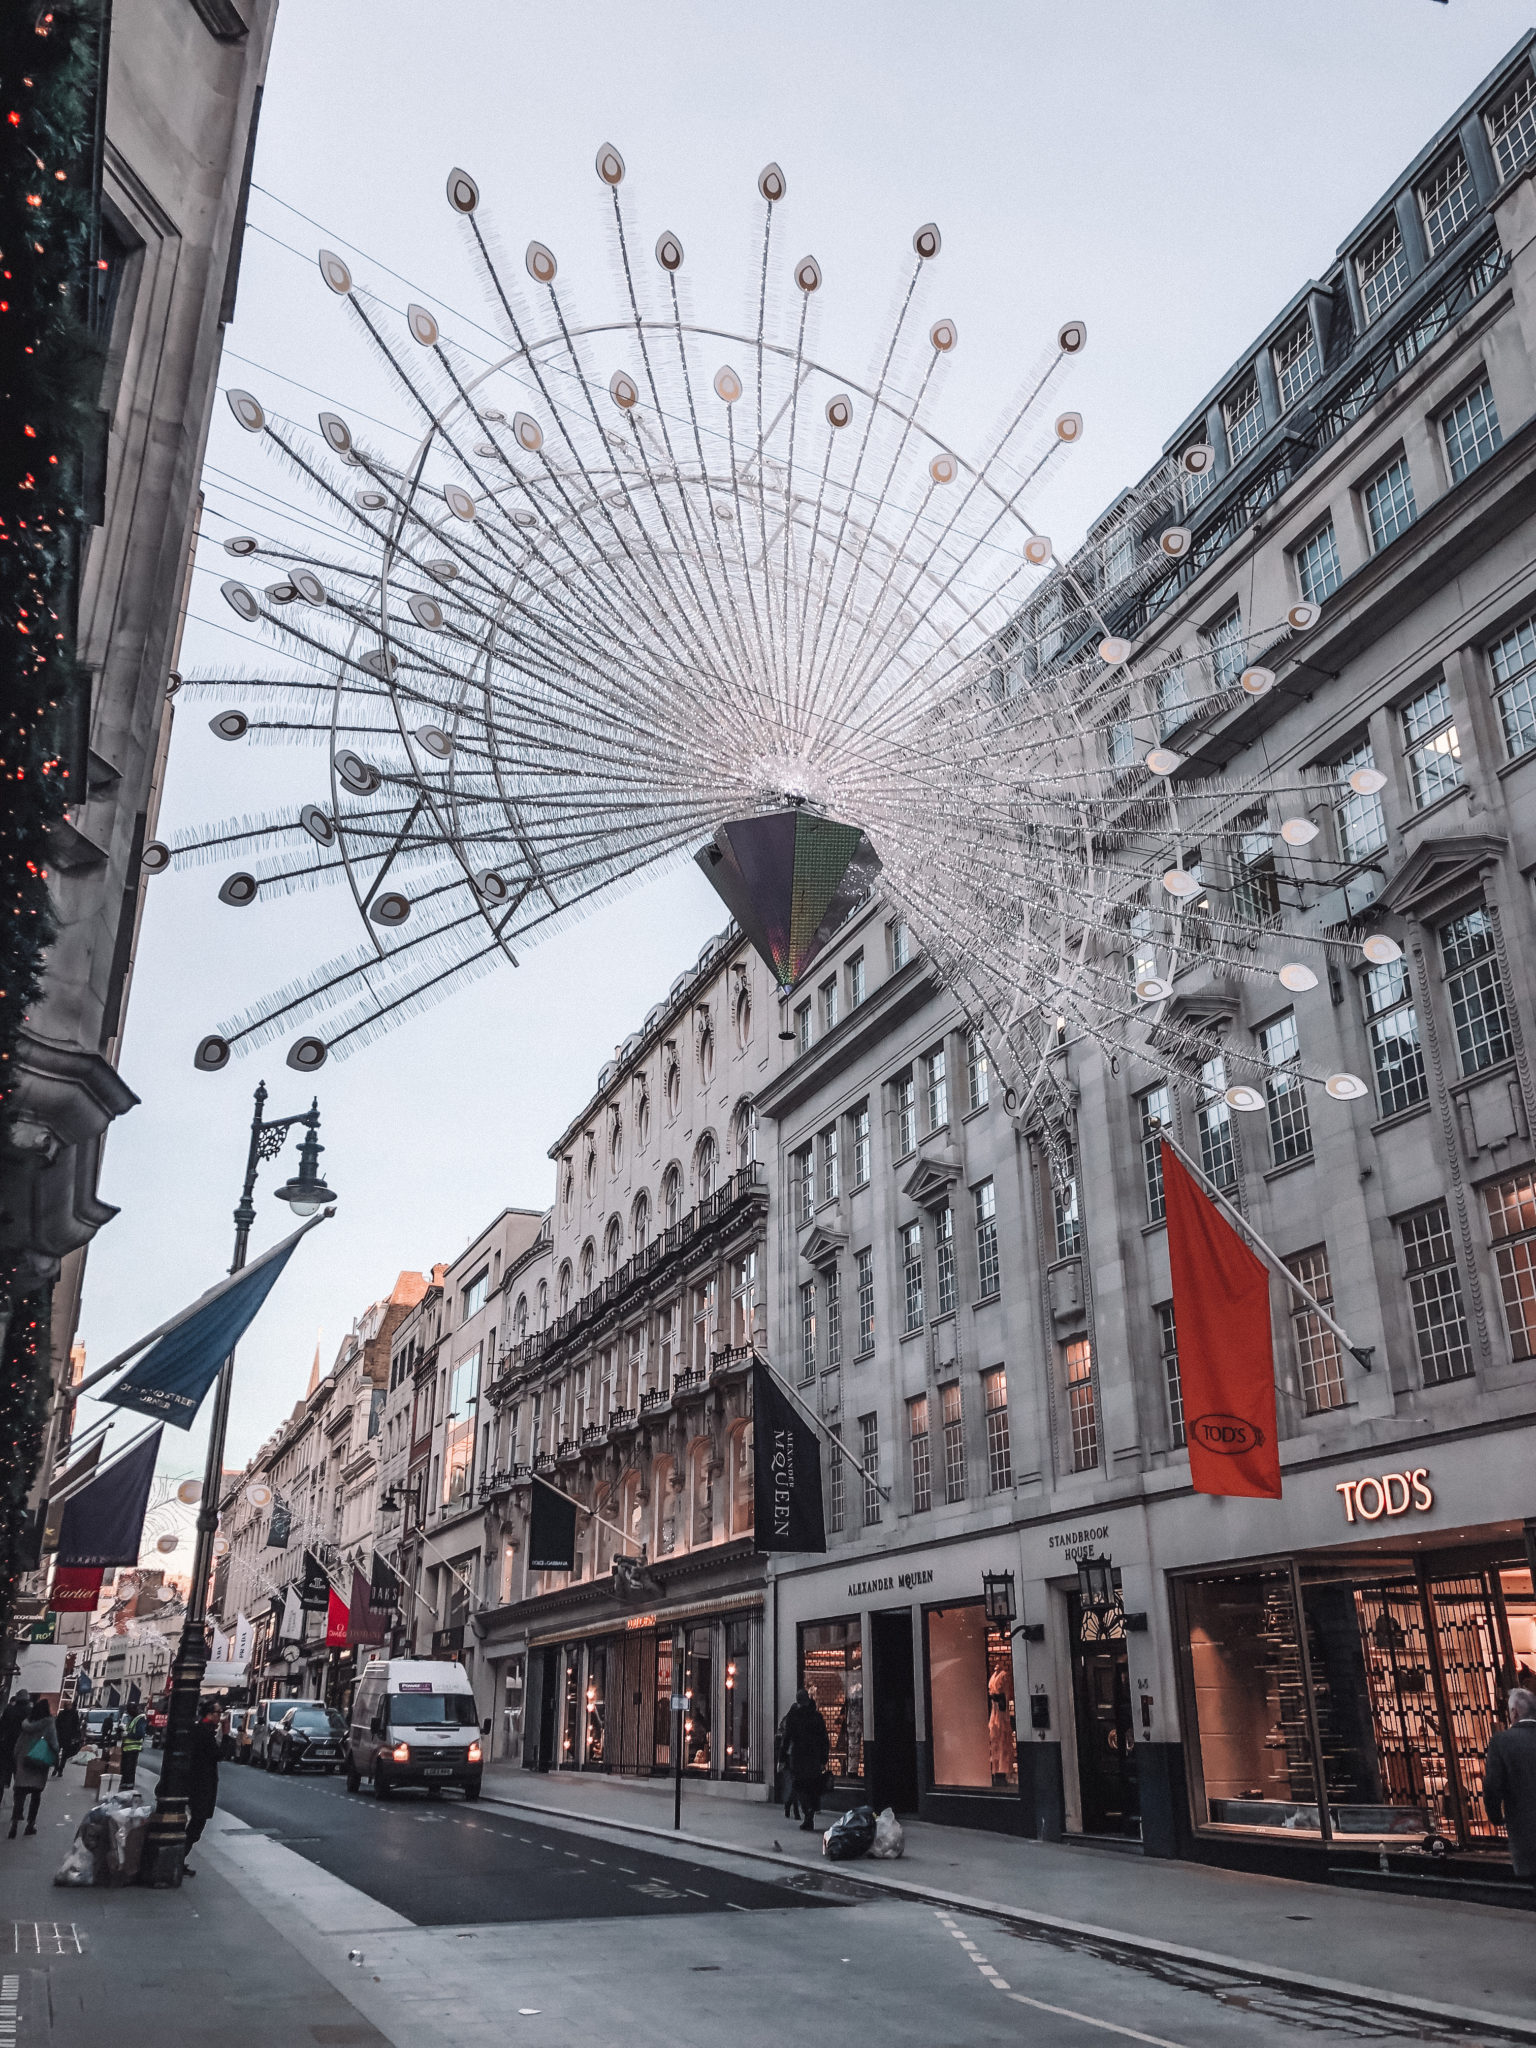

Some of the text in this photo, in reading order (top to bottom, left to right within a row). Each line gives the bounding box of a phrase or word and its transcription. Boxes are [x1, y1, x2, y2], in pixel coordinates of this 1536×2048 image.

[1202, 1424, 1246, 1443] TOD'S
[1335, 1468, 1433, 1522] TOD'S
[1049, 1526, 1109, 1548] STANDBROOK
[1065, 1544, 1095, 1561] HOUSE
[53, 1584, 98, 1599] Cartier
[847, 1577, 894, 1597] ALEXANDER
